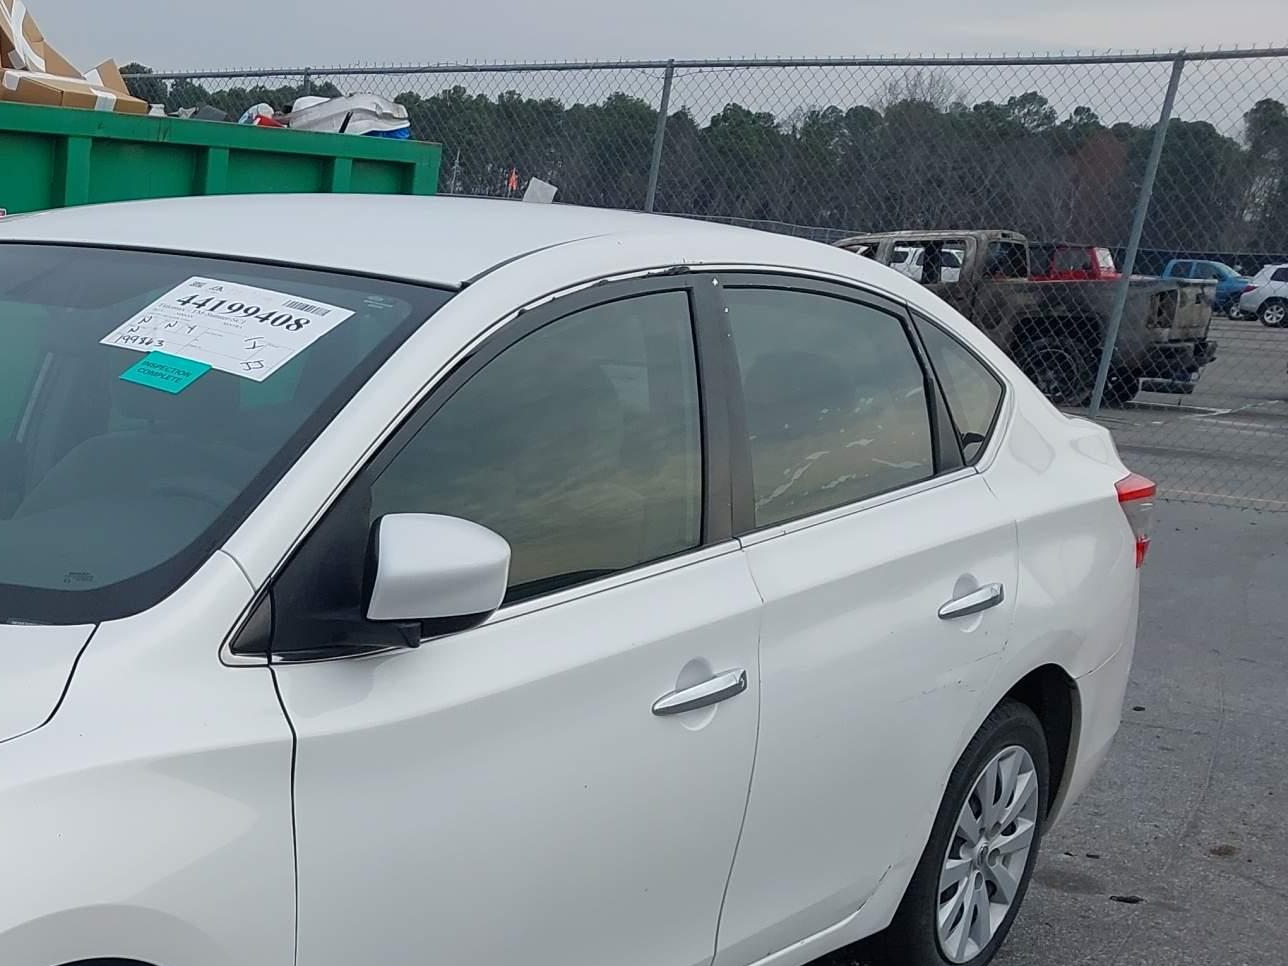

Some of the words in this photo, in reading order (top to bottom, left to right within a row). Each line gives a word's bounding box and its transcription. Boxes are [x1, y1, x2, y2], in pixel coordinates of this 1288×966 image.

[176, 294, 311, 332] 44199408
[136, 368, 184, 383] COMPLETE
[142, 361, 193, 378] INSPECTION
